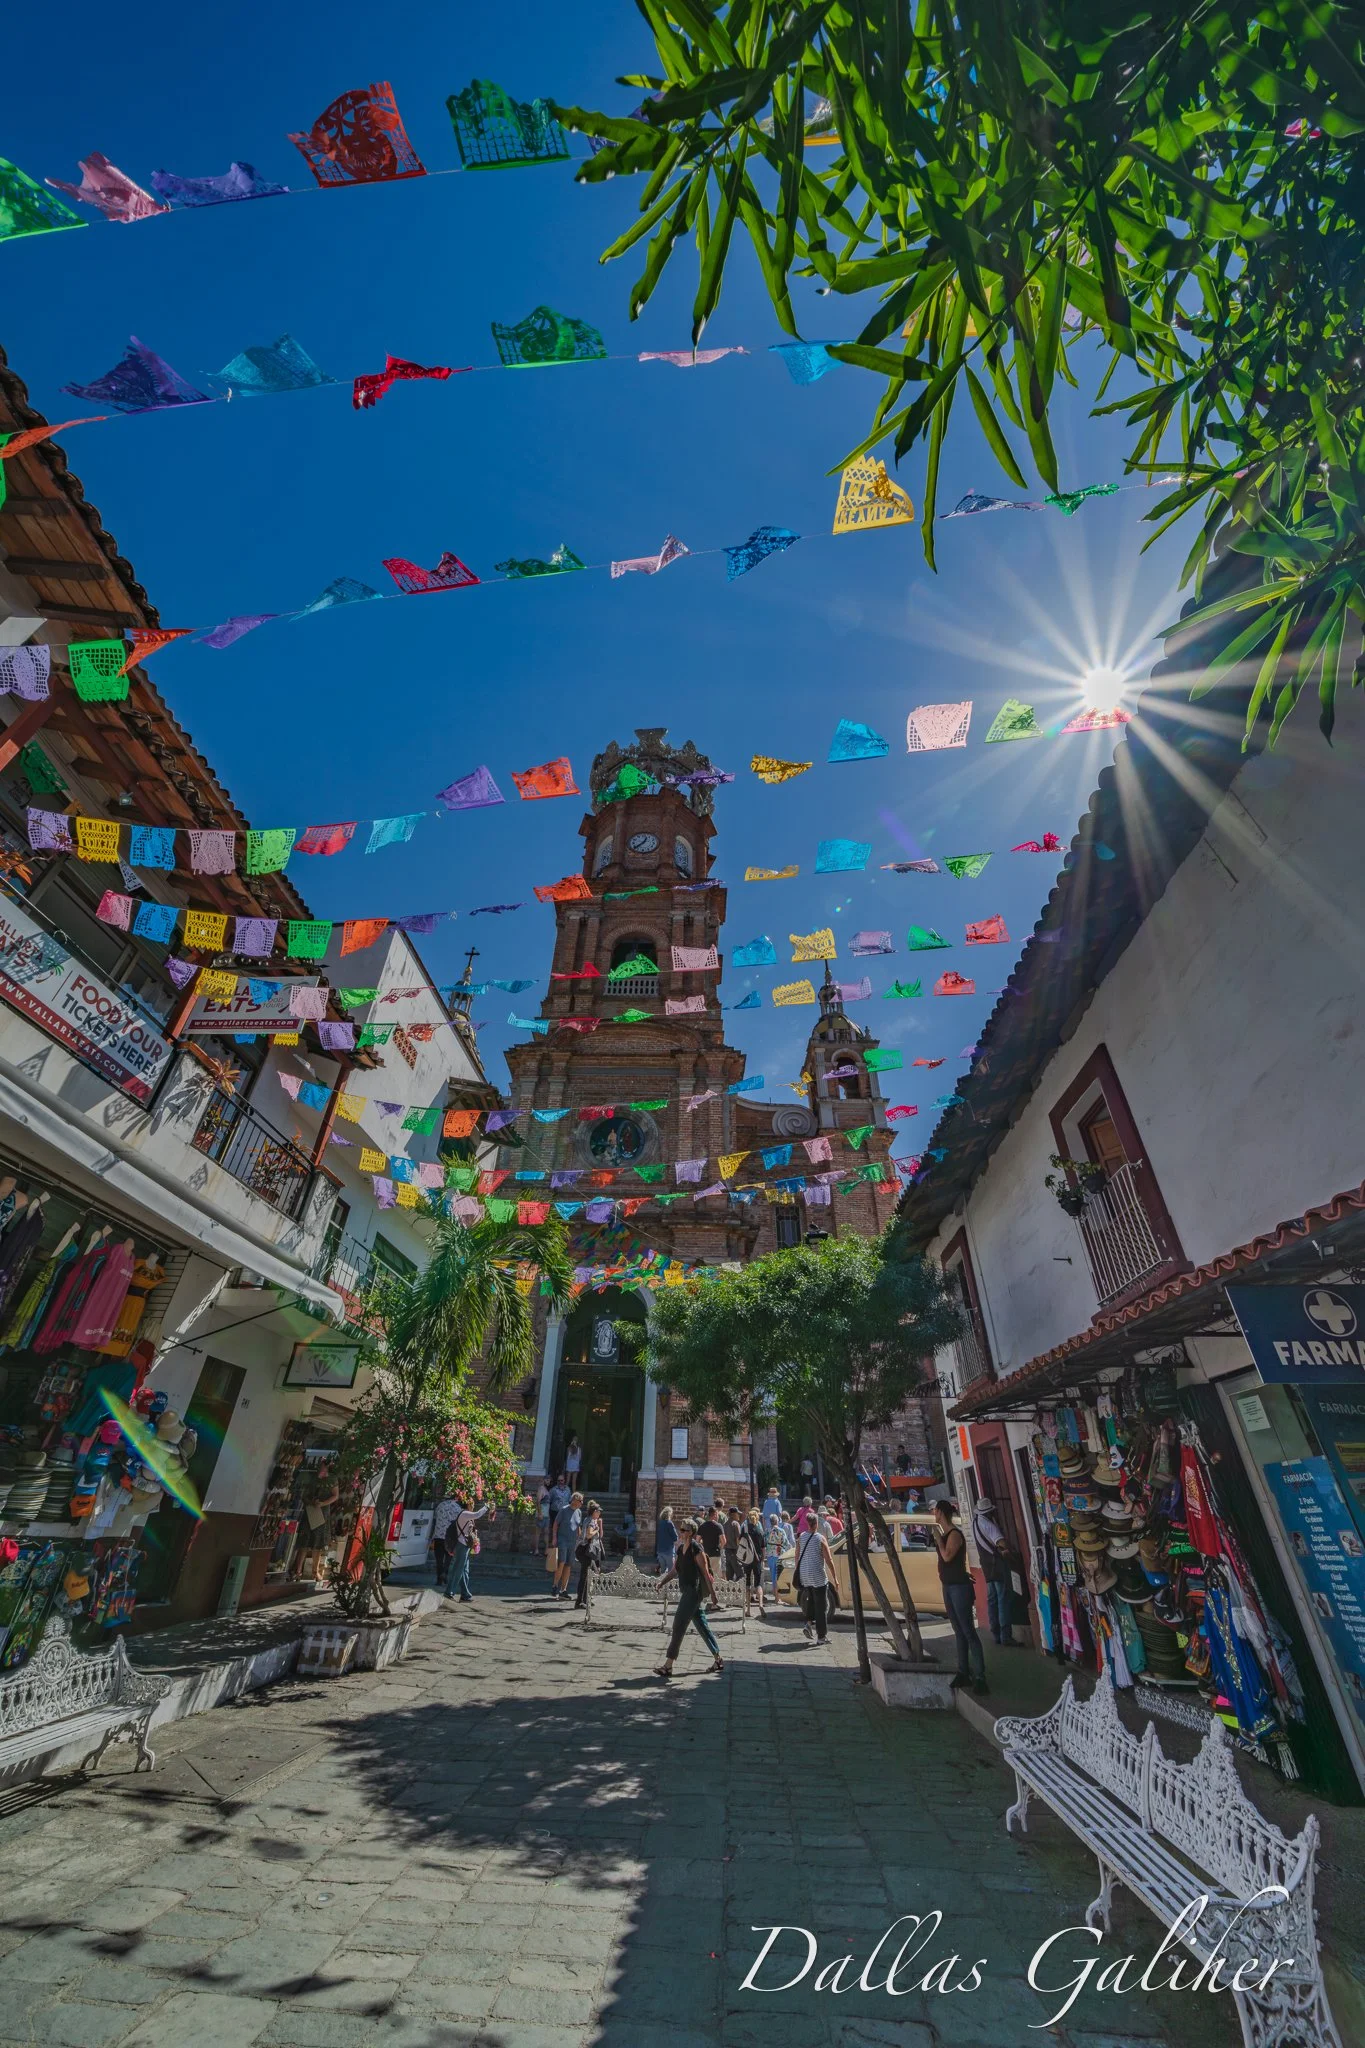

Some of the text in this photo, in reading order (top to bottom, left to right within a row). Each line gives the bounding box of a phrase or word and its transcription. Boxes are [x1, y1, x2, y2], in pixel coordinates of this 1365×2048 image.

[0, 915, 44, 964] ALLARTA
[70, 974, 164, 1063] FOOD TOUR
[203, 997, 262, 1013] EATS
[62, 993, 157, 1079] TICKETS HERE!
[1283, 1472, 1314, 1483] FARMACIA
